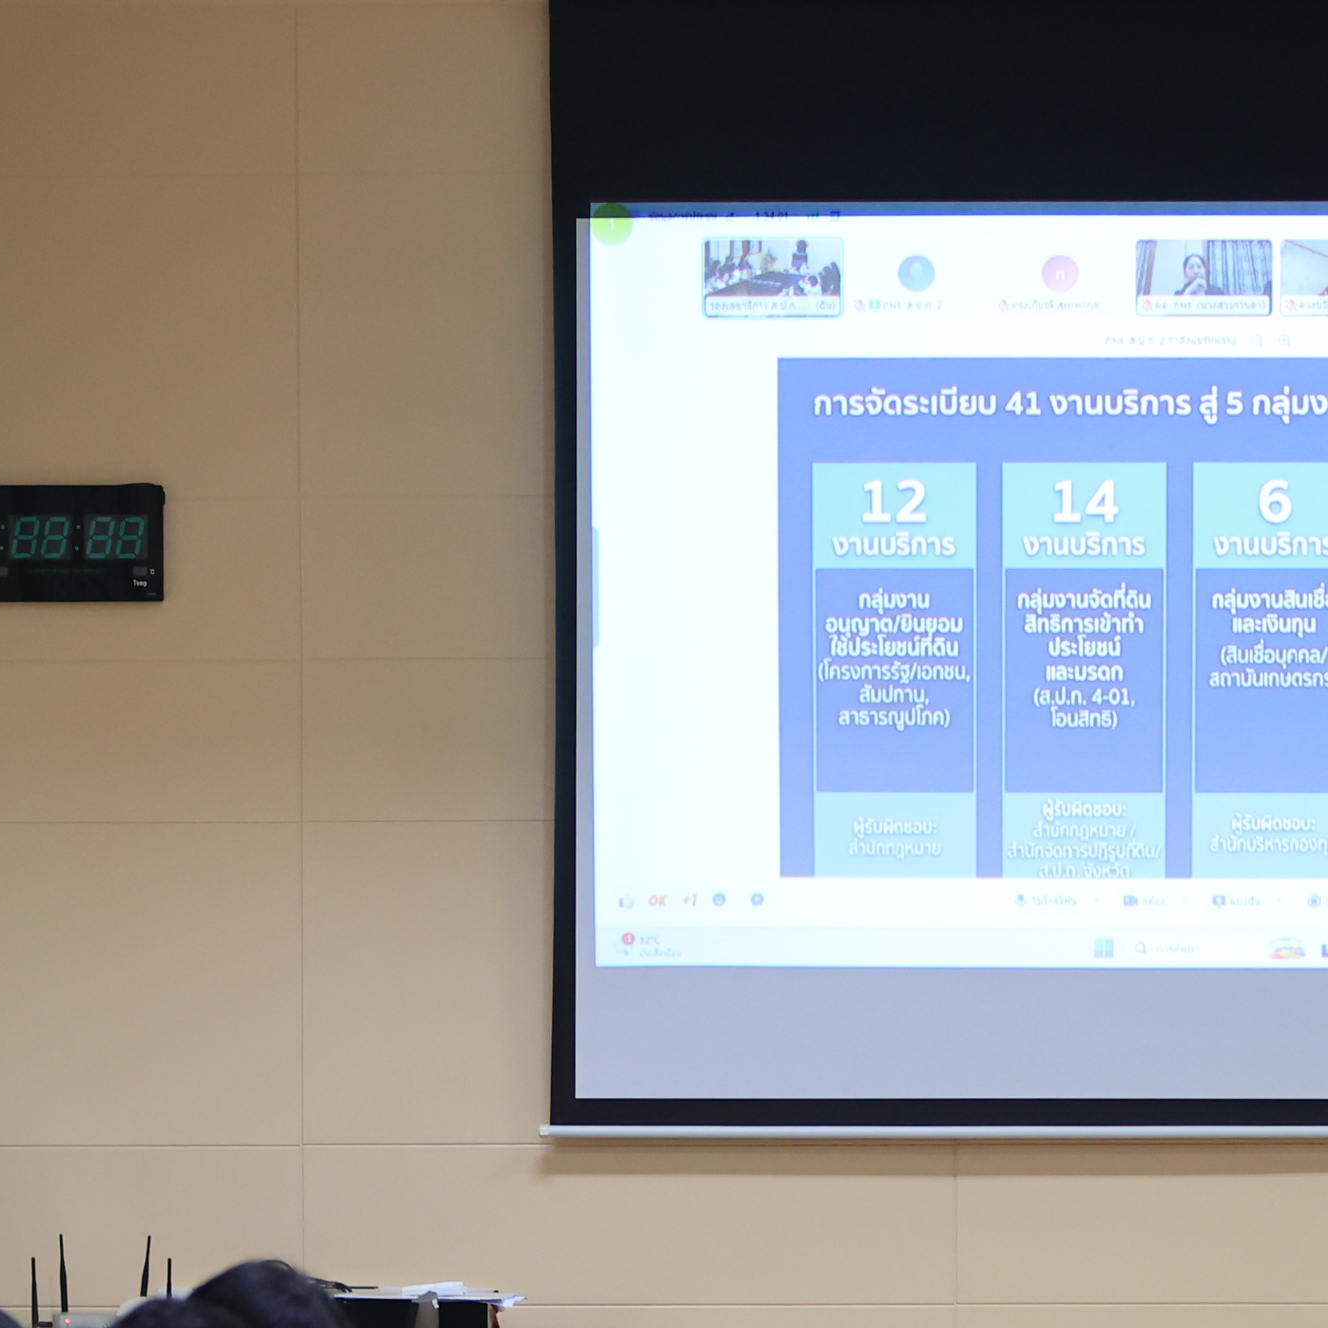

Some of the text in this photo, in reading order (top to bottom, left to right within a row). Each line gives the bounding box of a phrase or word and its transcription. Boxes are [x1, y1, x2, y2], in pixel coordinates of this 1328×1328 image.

[813, 387, 997, 417] การจัดระเบียบ
[1005, 391, 1042, 417] 41
[1049, 387, 1191, 417] งานบริการ
[1199, 386, 1219, 424] สู่
[1226, 391, 1244, 417] 5
[861, 479, 927, 524] 12
[1053, 479, 1120, 524] 14
[1258, 479, 1292, 524] 6
[832, 529, 955, 560] งานบริการ
[1022, 529, 1146, 560] งานบริการ
[132, 579, 148, 588] Temp
[859, 588, 930, 615] กลุ่มงาน
[1017, 582, 1151, 615] กลุ่มงานจัดที่ดิน
[825, 613, 963, 635] อนุญาต/ยินยอม
[1232, 611, 1316, 638] และเงินทุน
[831, 629, 959, 657] ใช้ประโยชน์ที่ดิน
[1048, 635, 1121, 657] ประโยชน์
[1045, 663, 1123, 682] และมรดก
